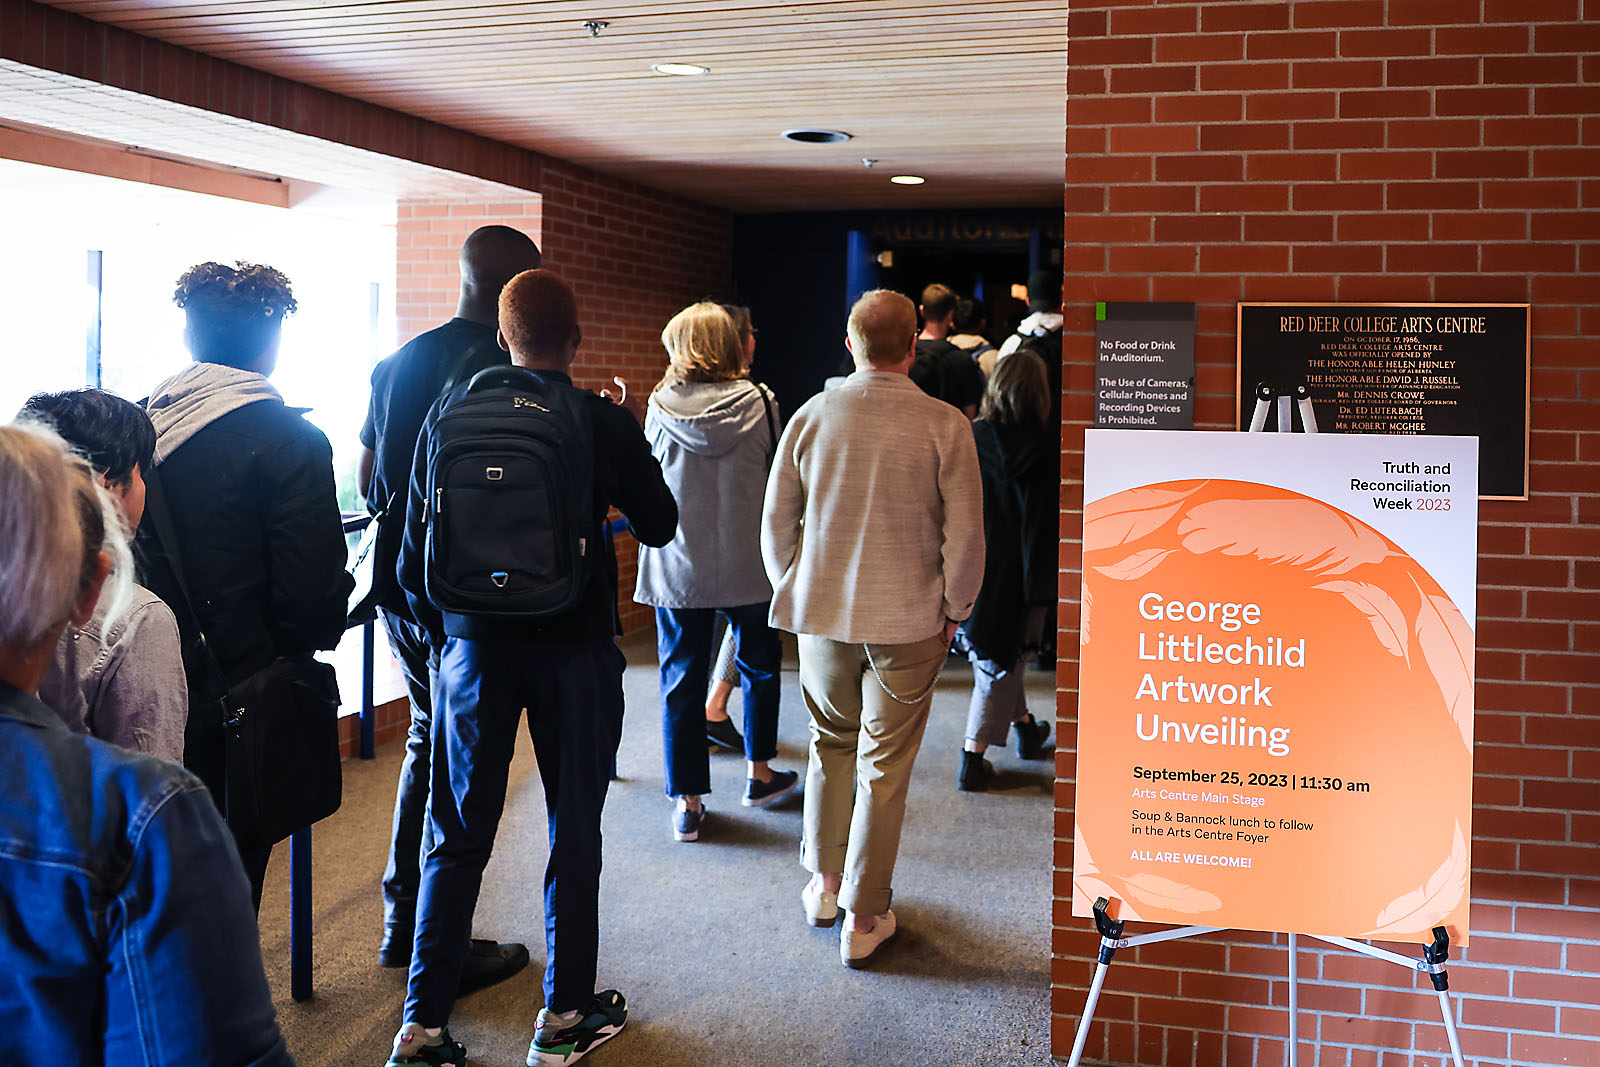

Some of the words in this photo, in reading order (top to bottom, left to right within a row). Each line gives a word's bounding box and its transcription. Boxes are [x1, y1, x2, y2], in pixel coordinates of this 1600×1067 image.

[1281, 317, 1304, 331] RED
[1309, 317, 1339, 332] DEER
[1344, 317, 1397, 332] COLLEGE
[1401, 317, 1432, 332] ARTS
[1437, 317, 1486, 333] CENTRE
[1101, 341, 1113, 349] No
[1115, 341, 1137, 349] Food
[1151, 341, 1175, 349] Drink
[1101, 353, 1108, 361] in
[1111, 353, 1164, 362] Auditorium.
[1328, 360, 1383, 368] HONORABLE
[1100, 378, 1116, 386] The
[1137, 378, 1146, 386] of
[1148, 379, 1188, 388] Cameras,
[1100, 390, 1133, 399] Cellular
[1135, 391, 1168, 399] Phones
[1170, 392, 1187, 400] and
[1100, 403, 1144, 414] Recording
[1147, 404, 1180, 412] Devices
[1370, 407, 1422, 415] LUTERBACH
[1100, 415, 1106, 423] is
[1109, 416, 1157, 424] Prohibited.
[1352, 422, 1386, 430] ROBERT
[1383, 462, 1419, 473] Truth
[1424, 463, 1450, 474] and
[1351, 479, 1450, 492] Reconciliation
[1373, 498, 1412, 509] Week
[1417, 499, 1450, 511] 2023
[1139, 593, 1261, 630] George
[1139, 632, 1305, 667] Littlechild
[1135, 674, 1272, 706] Artwork
[1136, 714, 1291, 756] Unveiling
[1134, 767, 1216, 782] September
[1221, 772, 1243, 786] 25,
[1248, 773, 1287, 787] 2023
[1301, 777, 1342, 790] 11:30
[1347, 782, 1369, 792] am
[1132, 788, 1156, 799] Arts
[1160, 789, 1198, 801] Centre
[1202, 792, 1228, 803] Main
[1232, 794, 1265, 808] Stage
[1132, 810, 1160, 825] Soup
[1165, 812, 1172, 821] &
[1177, 813, 1225, 825] Bannock
[1230, 816, 1259, 827] lunch
[1264, 819, 1275, 828] to
[1279, 819, 1313, 830] follow
[1132, 824, 1141, 834] in
[1145, 826, 1163, 836] the
[1167, 827, 1190, 837] Arts
[1195, 829, 1233, 840] Centre
[1237, 832, 1269, 844] Foyer
[1131, 850, 1153, 861] ALL
[1155, 852, 1180, 863] ARE
[1183, 853, 1251, 868] WELCOME!
